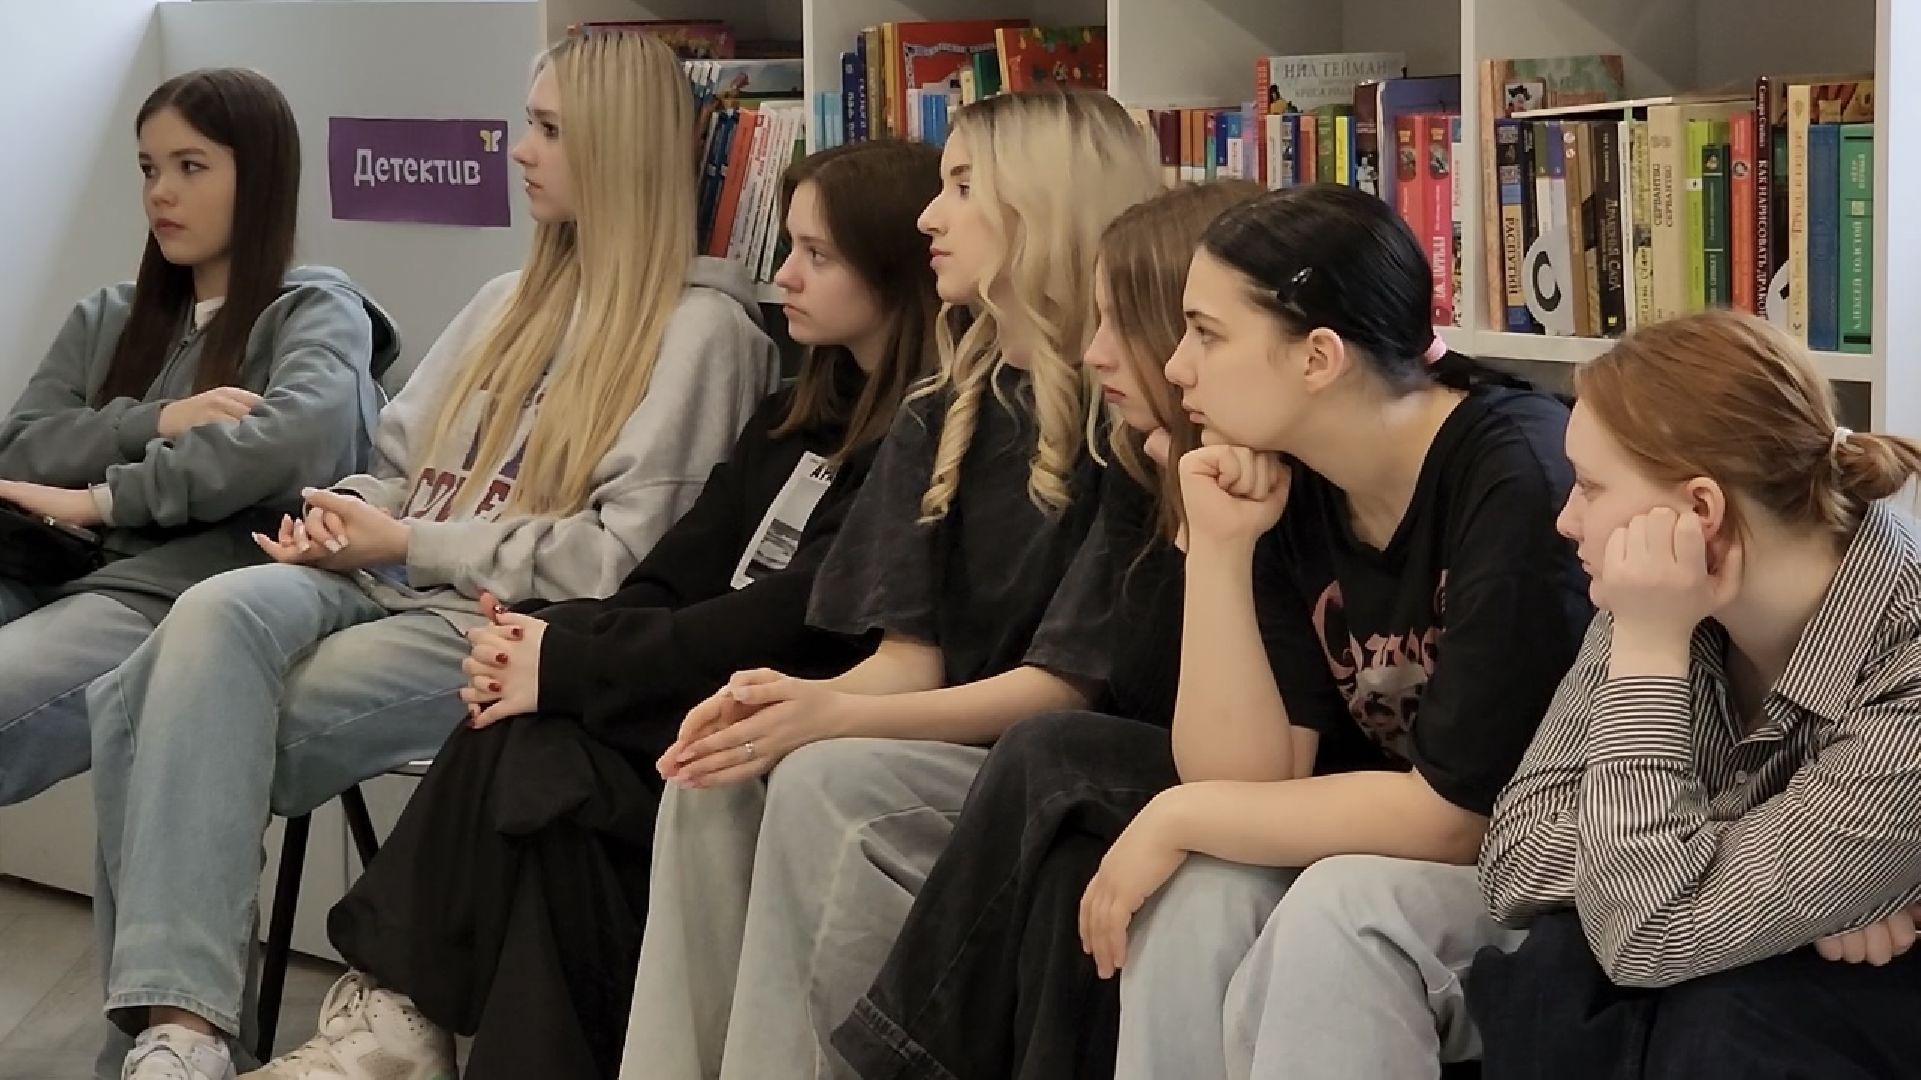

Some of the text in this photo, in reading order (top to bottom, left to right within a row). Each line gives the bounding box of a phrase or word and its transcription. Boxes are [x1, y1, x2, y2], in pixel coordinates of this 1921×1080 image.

[1284, 58, 1388, 78] НИЛ ГЕЙМАН
[353, 148, 481, 187] Детектив
[1652, 163, 1662, 226] СЕРВАНТЕС
[1663, 165, 1673, 228] СЕРВАНТЕС
[1757, 158, 1767, 183] КАК
[1504, 216, 1518, 294] РАСПУТИН
[1757, 185, 1767, 267] НАРИСОВАТЬ
